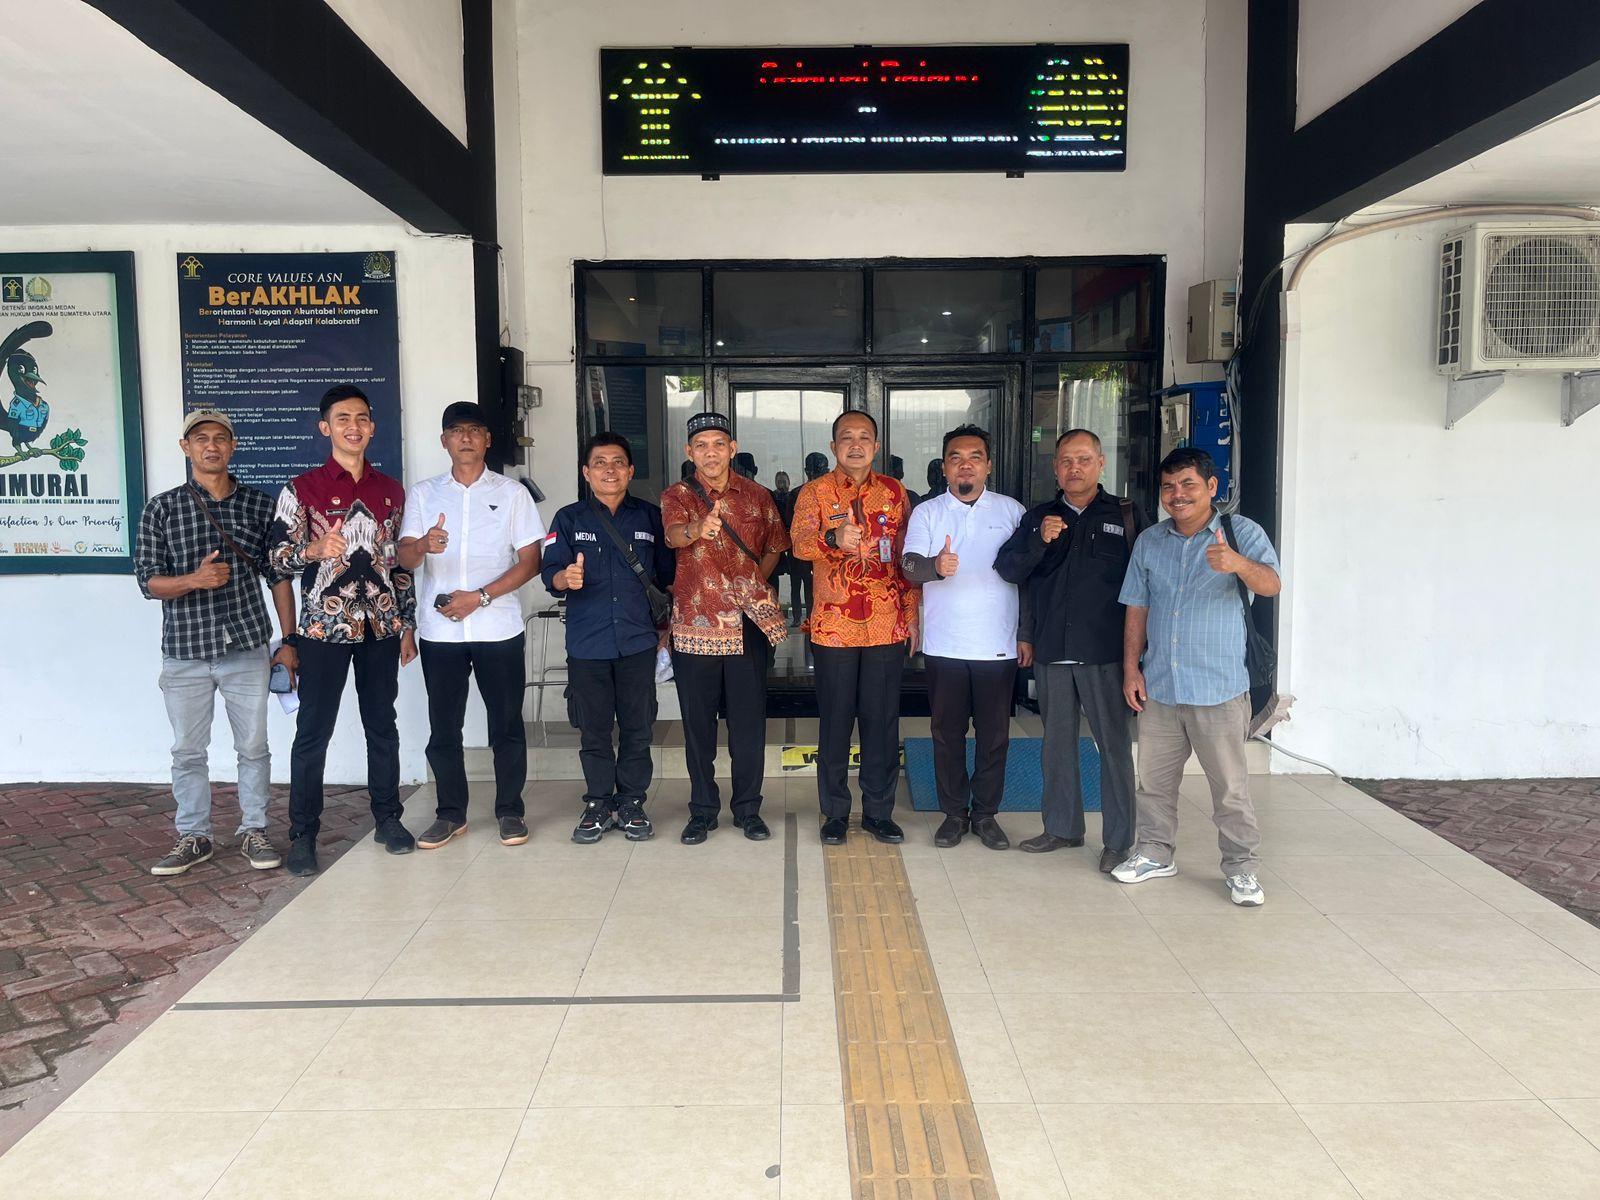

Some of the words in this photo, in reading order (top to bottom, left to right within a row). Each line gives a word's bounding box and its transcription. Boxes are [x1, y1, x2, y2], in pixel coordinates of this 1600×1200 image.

[227, 273, 263, 283] CORE
[268, 273, 313, 283] VALUES
[317, 273, 343, 283] ASN
[208, 286, 361, 306] BerAKHLAK
[199, 308, 246, 316] Berorientasi
[249, 308, 292, 317] Pelayanan
[293, 308, 336, 316] Akuntabel
[338, 308, 379, 317] Kompeten
[258, 318, 280, 327] Loyal
[283, 318, 313, 326] Adaptif
[44, 516, 54, 527] Is
[58, 516, 78, 526] Our
[575, 532, 597, 542] MEDIA
